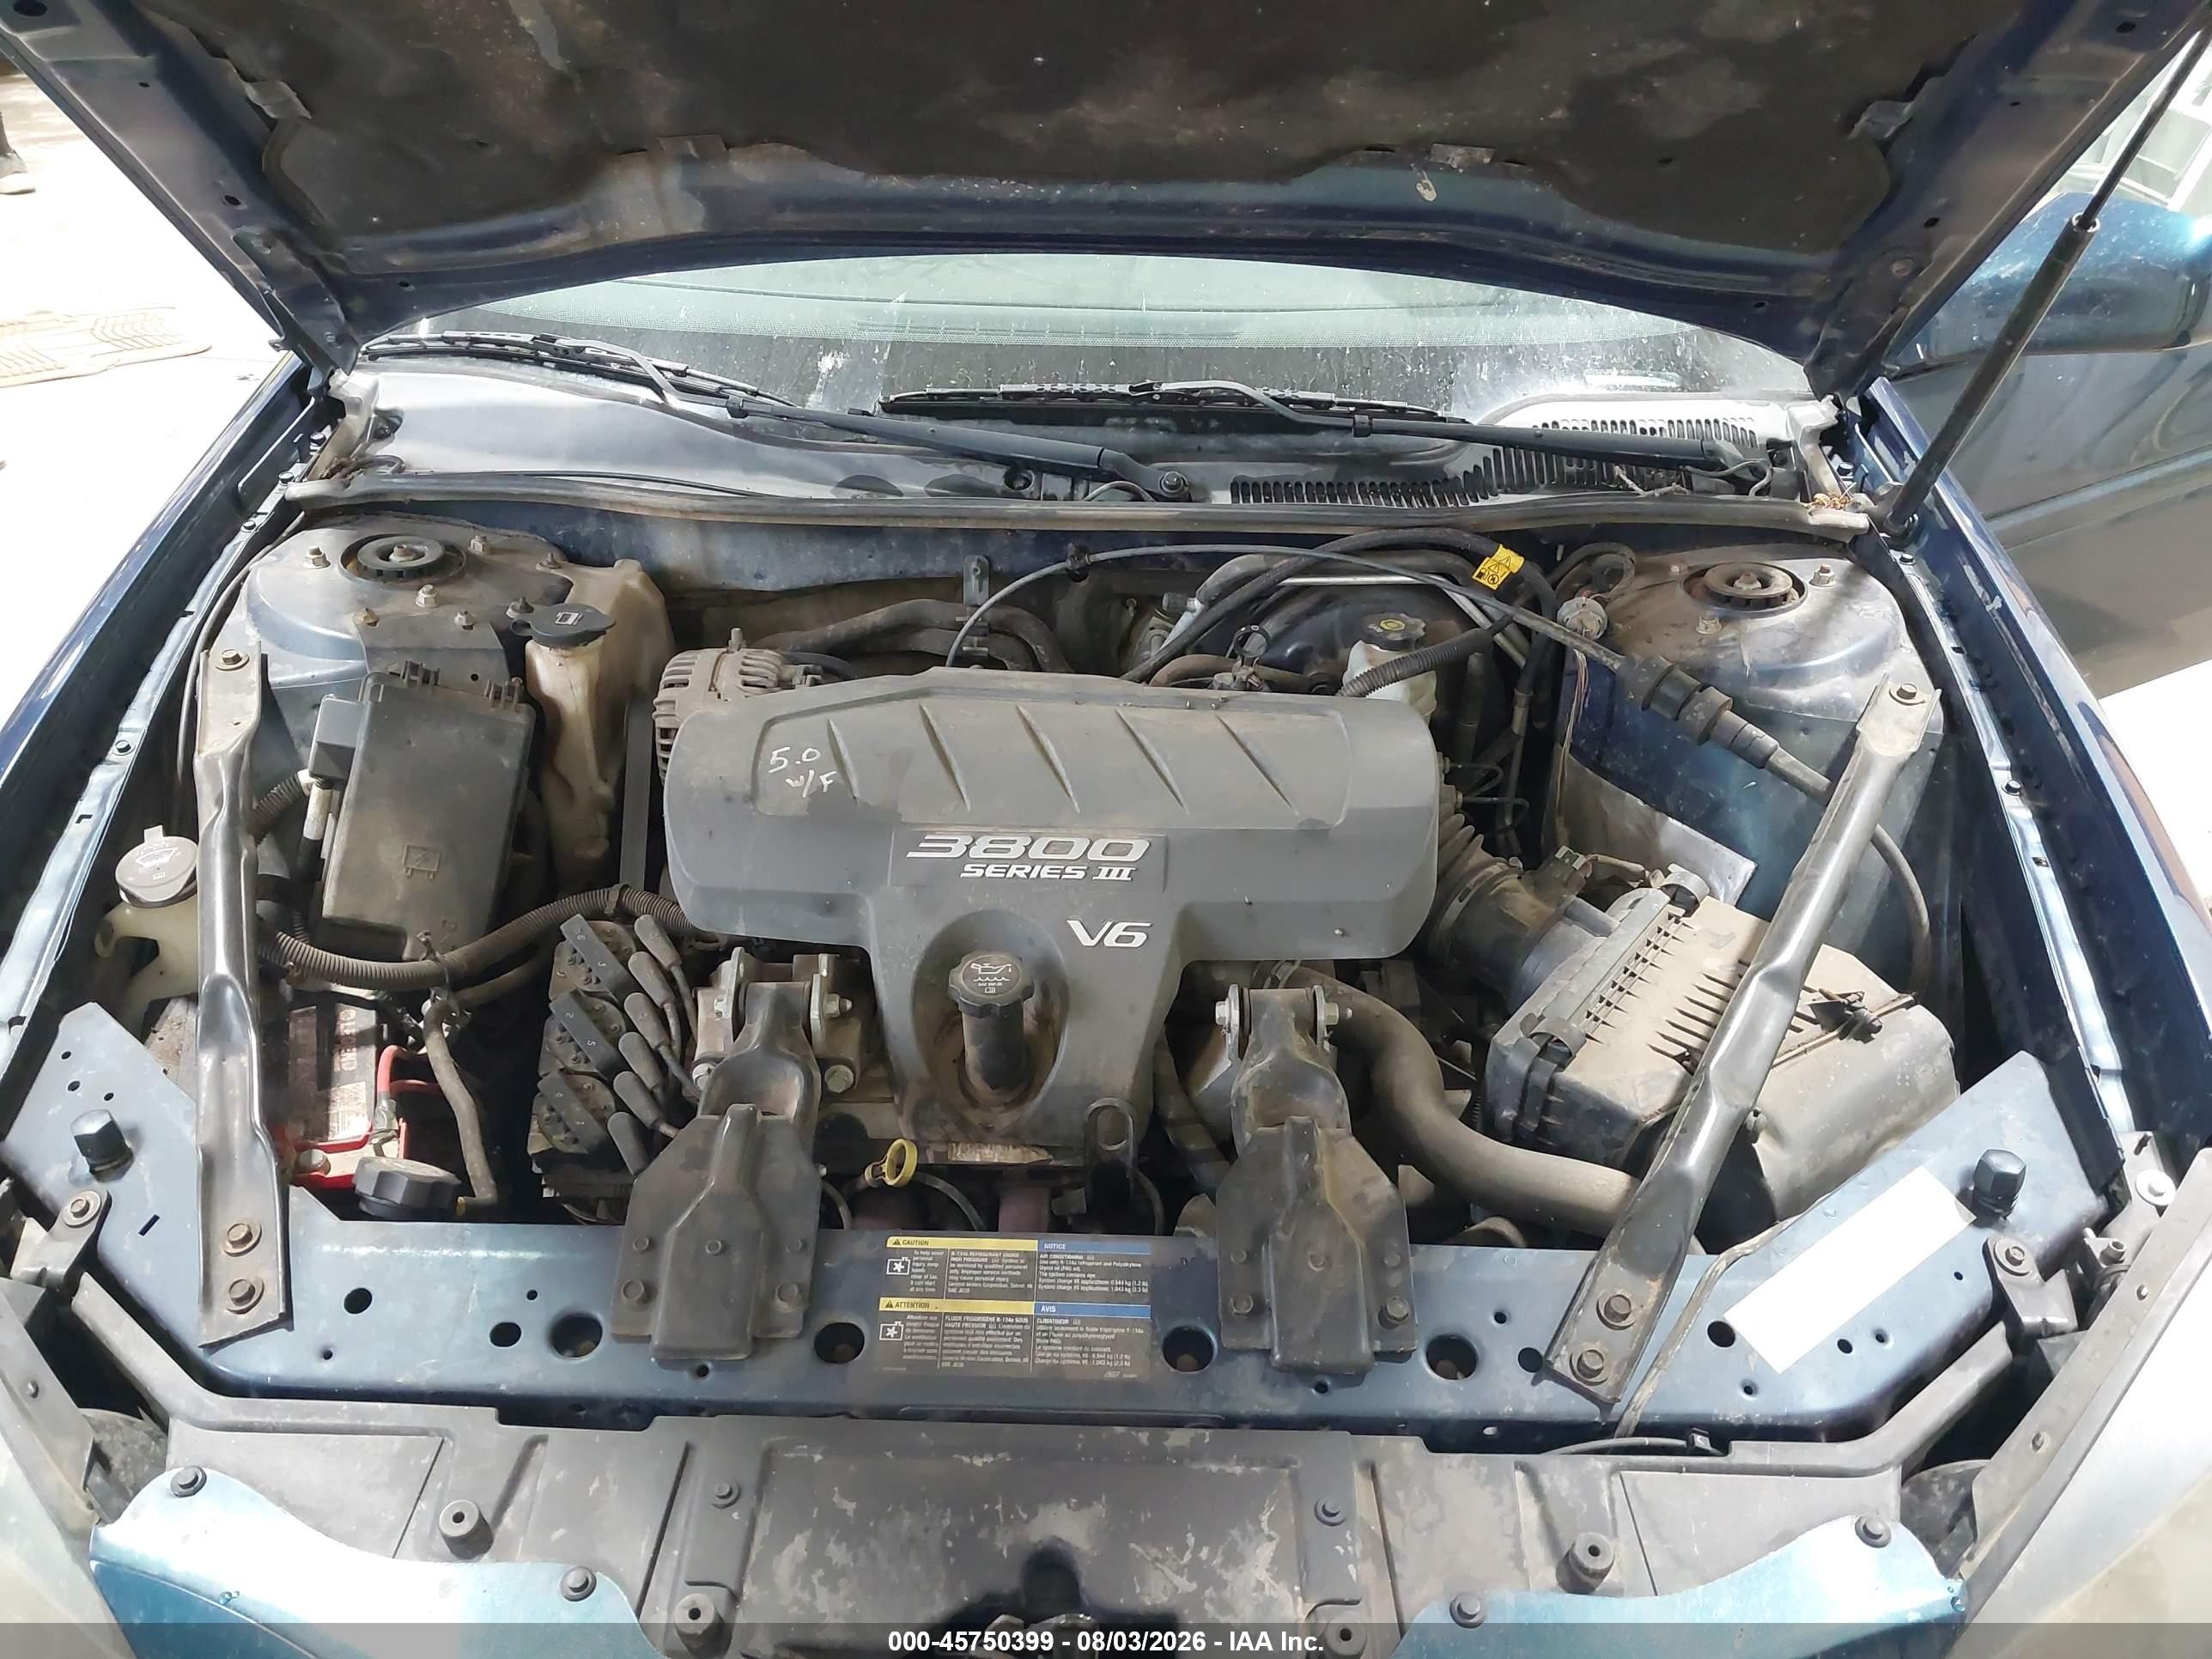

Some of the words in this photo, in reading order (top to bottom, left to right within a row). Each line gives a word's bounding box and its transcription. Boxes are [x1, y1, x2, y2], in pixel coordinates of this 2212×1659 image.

[769, 746, 822, 773] 5.0
[906, 834, 1152, 861] 3800
[960, 864, 1089, 880] SERIES
[1092, 866, 1137, 881] III
[1066, 919, 1153, 949] V6
